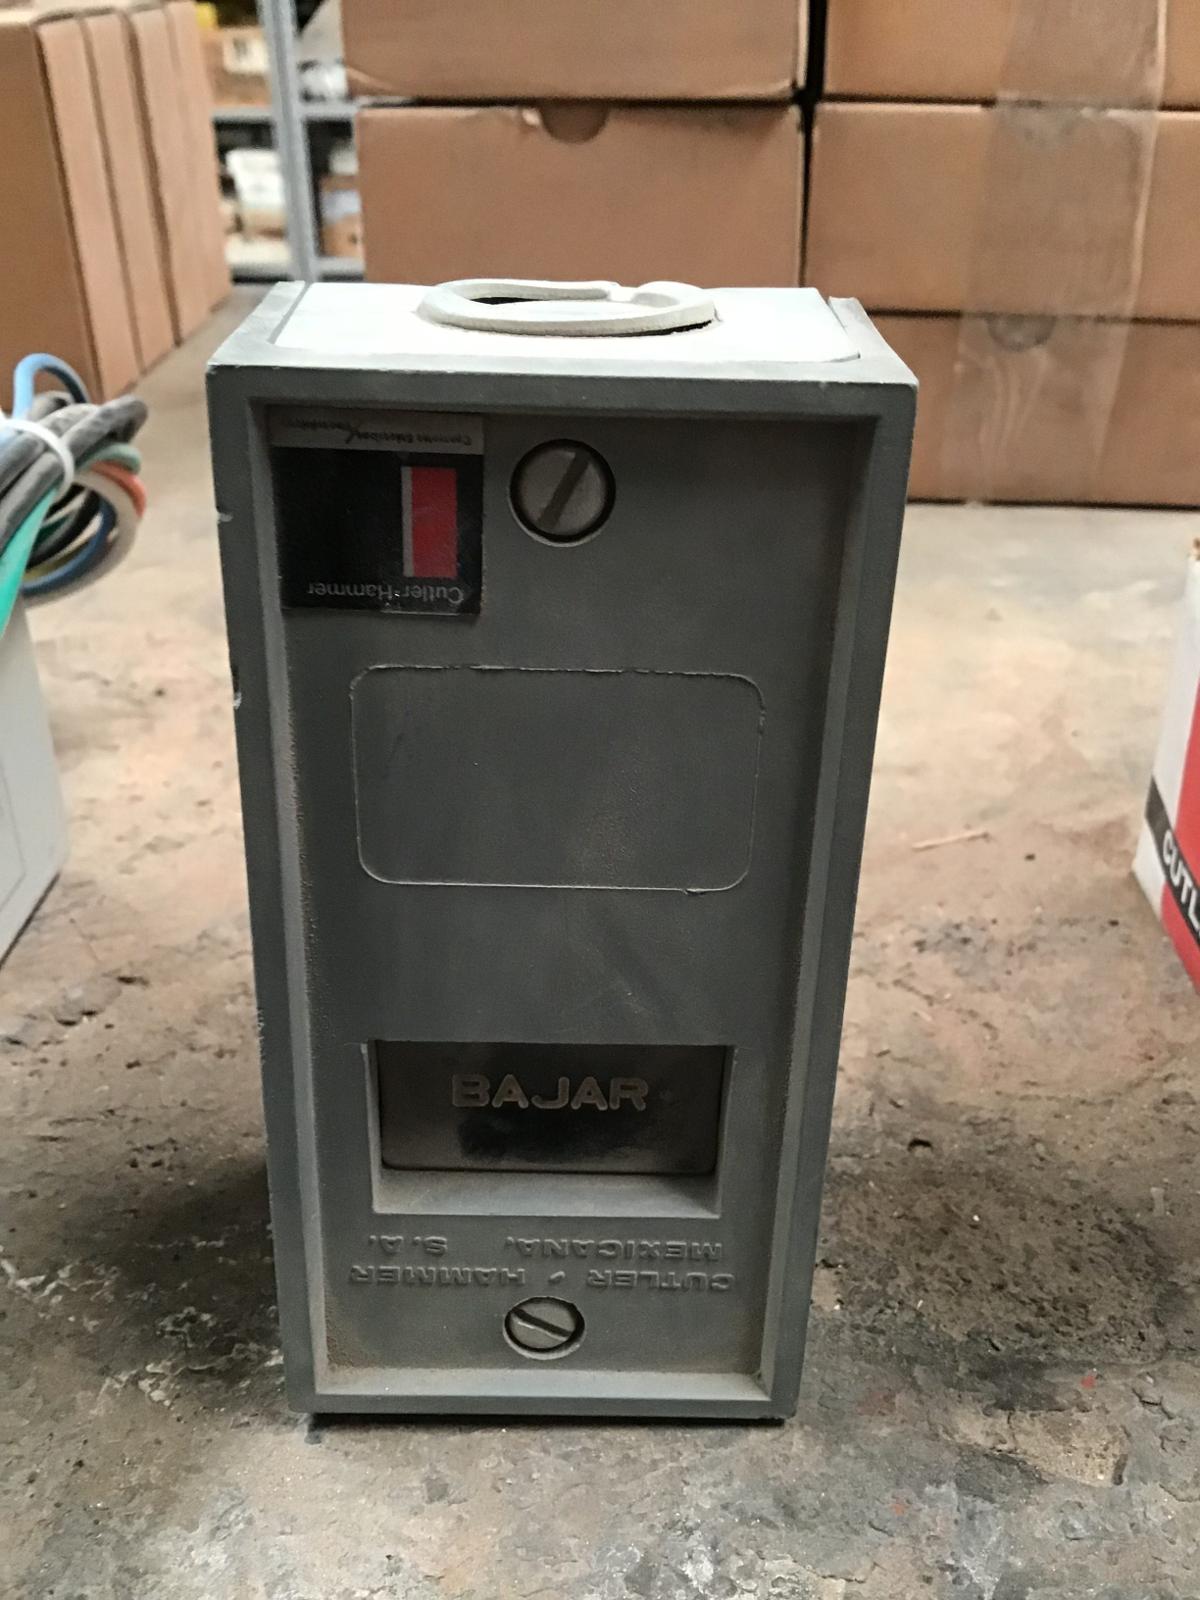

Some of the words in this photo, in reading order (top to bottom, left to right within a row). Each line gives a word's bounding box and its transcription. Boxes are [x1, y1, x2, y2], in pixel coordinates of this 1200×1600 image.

[307, 581, 465, 606] Cutler-Hammer
[1162, 829, 1200, 939] CUTL
[451, 1073, 650, 1112] BAJAR
[349, 1265, 526, 1288] HAMMER
[586, 1268, 735, 1292] CUTLER
